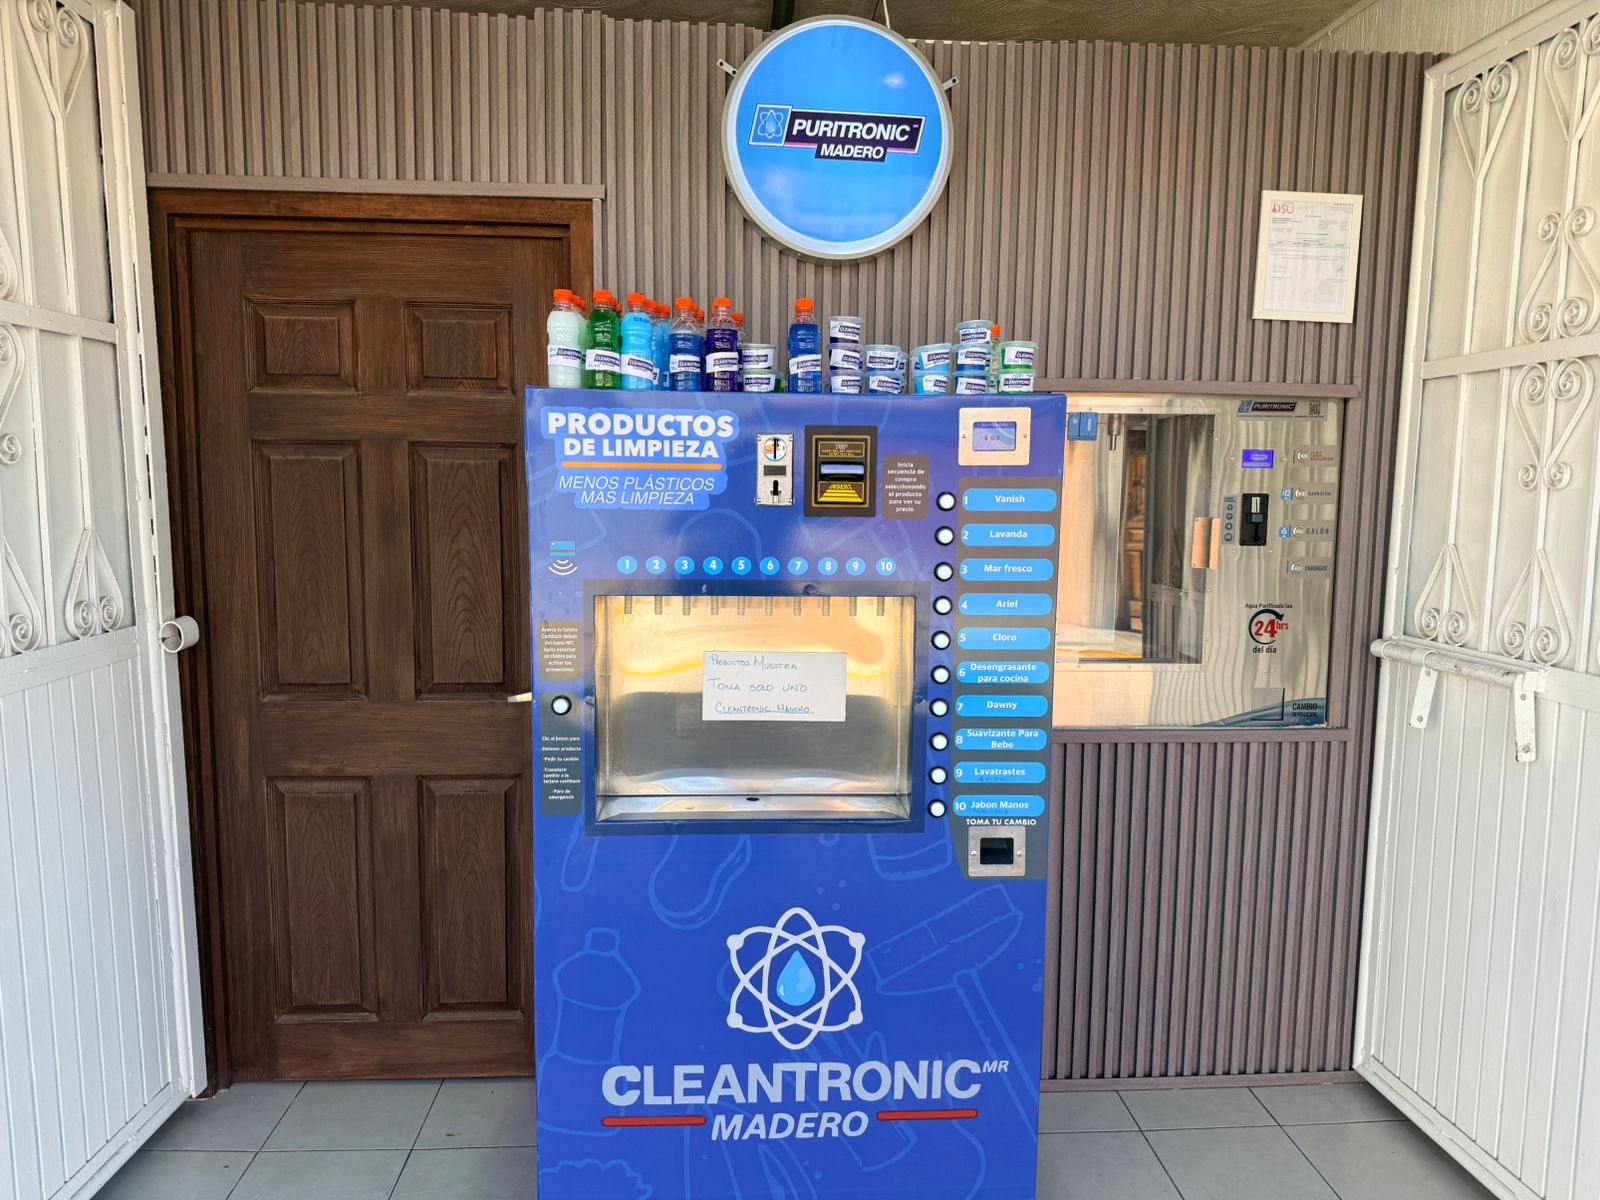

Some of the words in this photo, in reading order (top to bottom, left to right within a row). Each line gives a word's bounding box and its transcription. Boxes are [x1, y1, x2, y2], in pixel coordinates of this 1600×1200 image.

[792, 119, 911, 142] PURITRONIC
[820, 143, 884, 159] MADERO
[548, 412, 735, 438] PRODUCTOS
[564, 438, 596, 456] DE
[602, 438, 719, 458] LIMPIEZA
[559, 476, 619, 489] MENOS
[624, 474, 715, 491] PLÁSTICOS
[581, 491, 616, 503] MAS
[621, 492, 694, 505] LIMPIEZA
[963, 496, 969, 505] 1
[994, 495, 1025, 504] Vanish
[962, 530, 969, 540] 2
[990, 530, 1028, 538] Lavanda
[624, 560, 630, 570] 1
[652, 560, 660, 570] 2
[681, 560, 688, 570] 3
[710, 560, 718, 570] 4
[738, 560, 745, 570] 5
[767, 561, 774, 570] 6
[795, 561, 802, 570] 7
[824, 561, 832, 571] 8
[852, 561, 860, 571] 9
[880, 561, 893, 572] 10
[961, 565, 968, 574] 3
[984, 564, 1002, 572] Mar
[1004, 564, 1033, 572] fresco
[961, 600, 968, 609] 4
[996, 600, 1018, 608] Ariel
[1254, 619, 1278, 638] 24
[1276, 621, 1289, 630] hrs
[960, 633, 966, 642] 5
[992, 633, 1017, 642] Cloro
[1252, 646, 1264, 654] del
[1266, 646, 1277, 654] día
[959, 668, 966, 677] 6
[970, 664, 1036, 672] Desengrasante
[707, 678, 740, 692] TOMA
[978, 676, 998, 684] para
[1000, 675, 1028, 683] cocina
[714, 701, 770, 713] CLEANTRONIC
[958, 703, 964, 711] 7
[986, 701, 1018, 710] Dawny
[1292, 703, 1318, 711] CAMBIO
[956, 736, 963, 744] 8
[967, 729, 1016, 738] Suavizante
[1018, 729, 1039, 738] Para
[991, 740, 1014, 749] Bebe
[956, 769, 963, 777] 9
[974, 767, 1026, 776] Lavatrastes
[955, 802, 967, 811] 10
[970, 800, 997, 810] Jabon
[1000, 800, 1029, 810] Manos
[601, 1059, 982, 1106] CLEANTRONIC
[983, 1060, 1009, 1073] MR
[711, 1111, 869, 1142] MADERO
